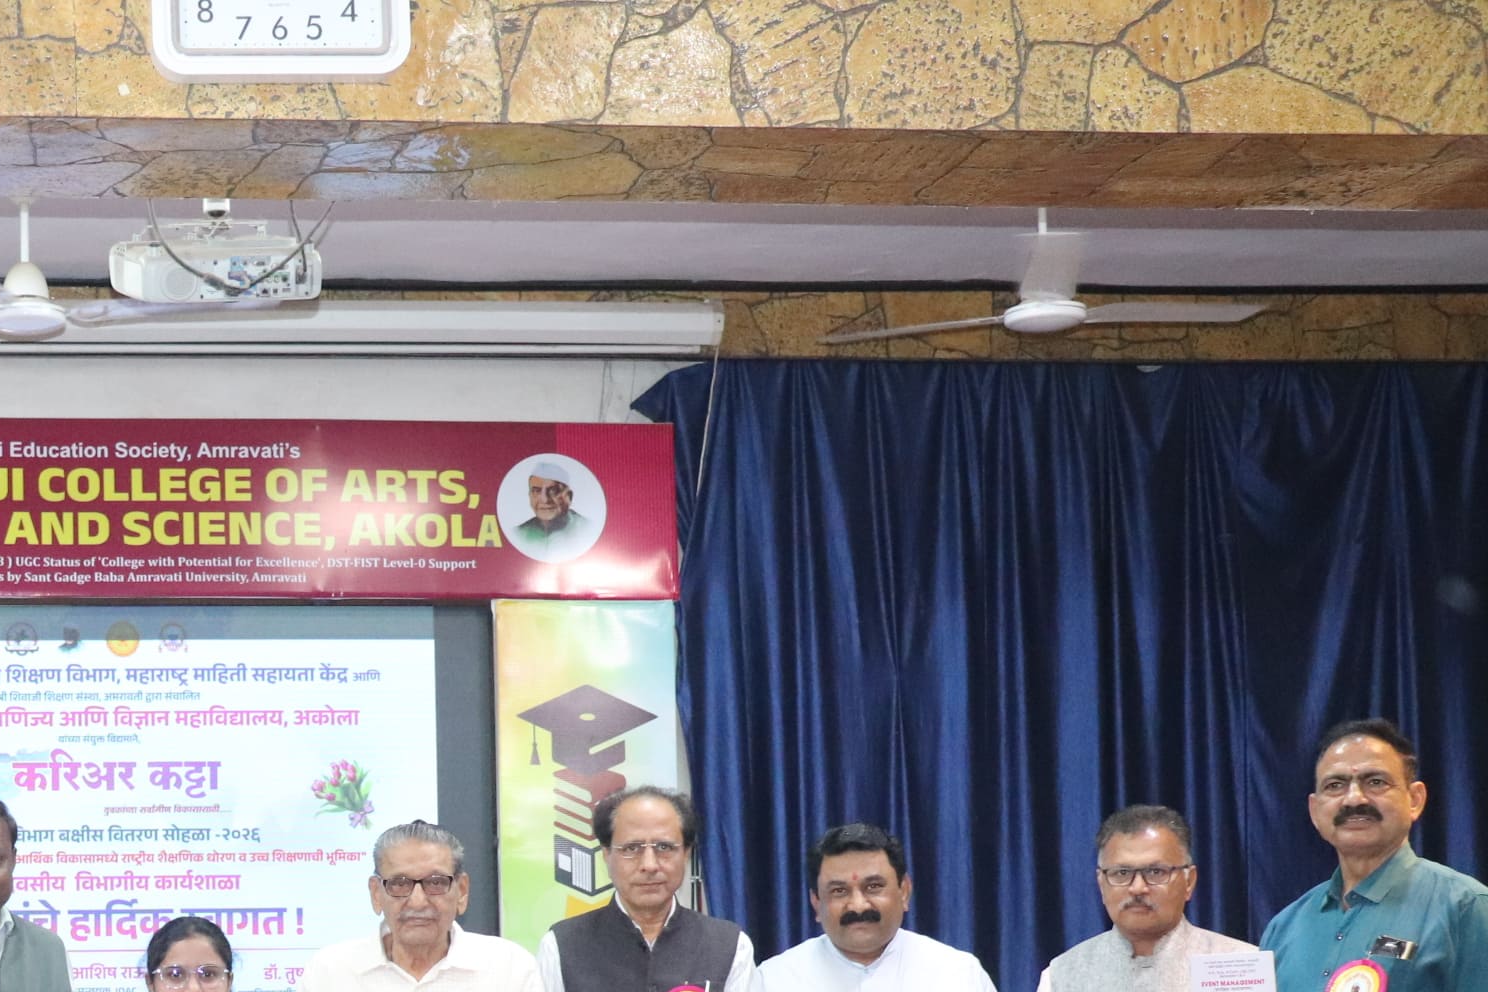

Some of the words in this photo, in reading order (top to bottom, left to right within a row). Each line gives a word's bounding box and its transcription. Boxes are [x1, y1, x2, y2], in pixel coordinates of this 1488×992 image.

[197, 0, 214, 23] 8
[340, 0, 358, 22] 4
[235, 16, 252, 40] 7
[272, 16, 289, 40] 6
[306, 15, 323, 41] 5
[9, 440, 109, 460] Education
[114, 441, 192, 463] Society,
[37, 467, 252, 503] COLLEGE
[265, 468, 327, 503] OF
[340, 470, 481, 510] ARTS,
[4, 510, 110, 545] AND
[122, 511, 337, 553] SCIENCE,
[348, 513, 503, 549] AKOLA
[15, 556, 41, 568] UGC
[43, 556, 81, 568] Status
[83, 556, 96, 568] of
[148, 556, 175, 568] with
[178, 556, 232, 568] Potential
[235, 556, 254, 568] for
[327, 558, 381, 569] DST-FIST
[428, 558, 477, 572] Support
[6, 570, 22, 585] by
[23, 571, 51, 584] Sant
[53, 571, 91, 585] Gadge
[94, 571, 125, 583] Baba
[127, 571, 183, 583] Amravati
[185, 571, 250, 585] University,
[251, 572, 307, 584] Amravati
[5, 664, 62, 685] शिक्षण
[65, 663, 121, 685] विभाग,
[125, 667, 189, 686] महाराष्ट्र
[193, 663, 248, 684] माहिती
[251, 667, 316, 684] सहायता
[318, 662, 350, 684] केंद्र
[352, 669, 381, 682] आणि
[59, 705, 109, 727] आणि
[113, 705, 170, 730] विज्ञान
[174, 705, 288, 728] महाविद्यालय,
[293, 704, 361, 726] अकोला
[11, 748, 137, 792] करिअर
[147, 760, 222, 799] कट्टा
[58, 824, 104, 843] बक्षीस
[108, 824, 159, 842] वितरण
[162, 824, 211, 843] सोहळा
[215, 827, 261, 843] -२०२६
[121, 850, 154, 866] राष्ट्रीय
[158, 850, 204, 863] शैक्षणिक
[239, 852, 247, 863] व
[249, 852, 270, 863] उच्च
[272, 848, 324, 863] शिक्षणाची
[74, 870, 150, 891] विभागीय
[154, 869, 242, 891] कार्यशाळा
[67, 899, 174, 942] हार्दिक
[72, 962, 117, 979] आशिष
[263, 963, 282, 980] डॉ.
